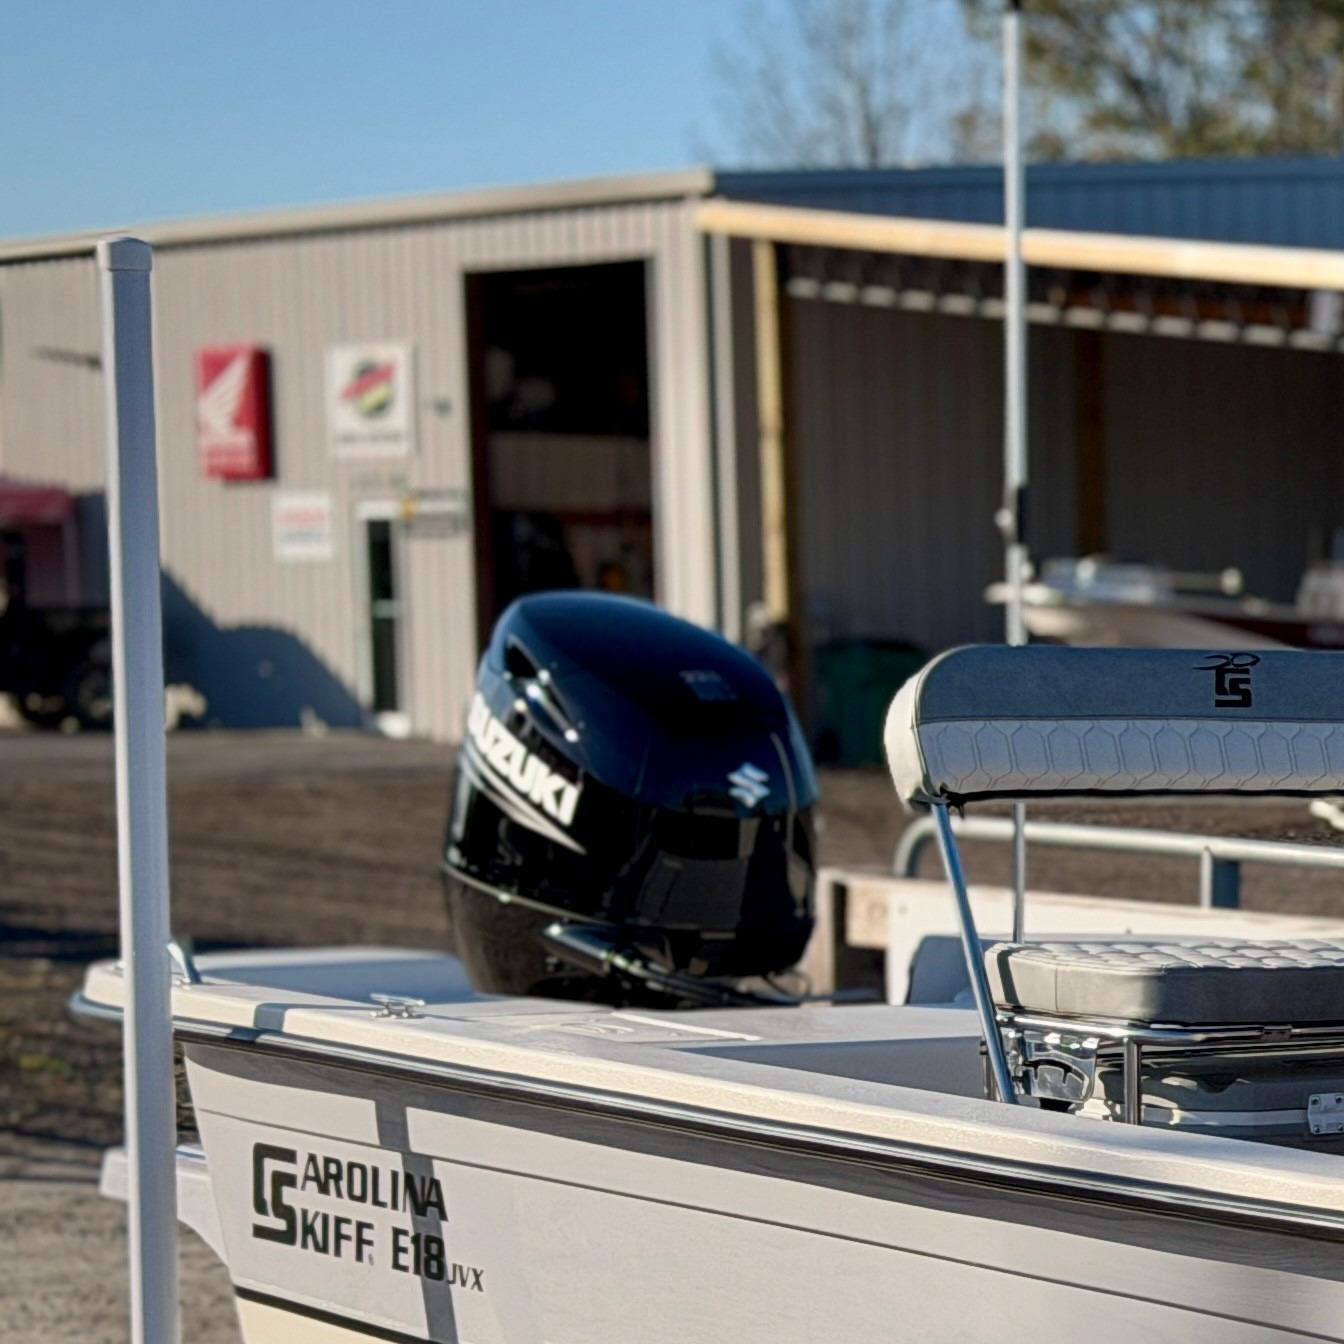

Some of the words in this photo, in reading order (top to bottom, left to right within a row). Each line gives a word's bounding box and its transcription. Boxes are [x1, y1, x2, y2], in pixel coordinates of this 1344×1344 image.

[466, 690, 581, 827] SUZUKI
[252, 1141, 449, 1222] CAROLINA
[252, 1169, 375, 1264] SKIFF
[391, 1225, 446, 1282] E18
[446, 1262, 486, 1293] JVX
